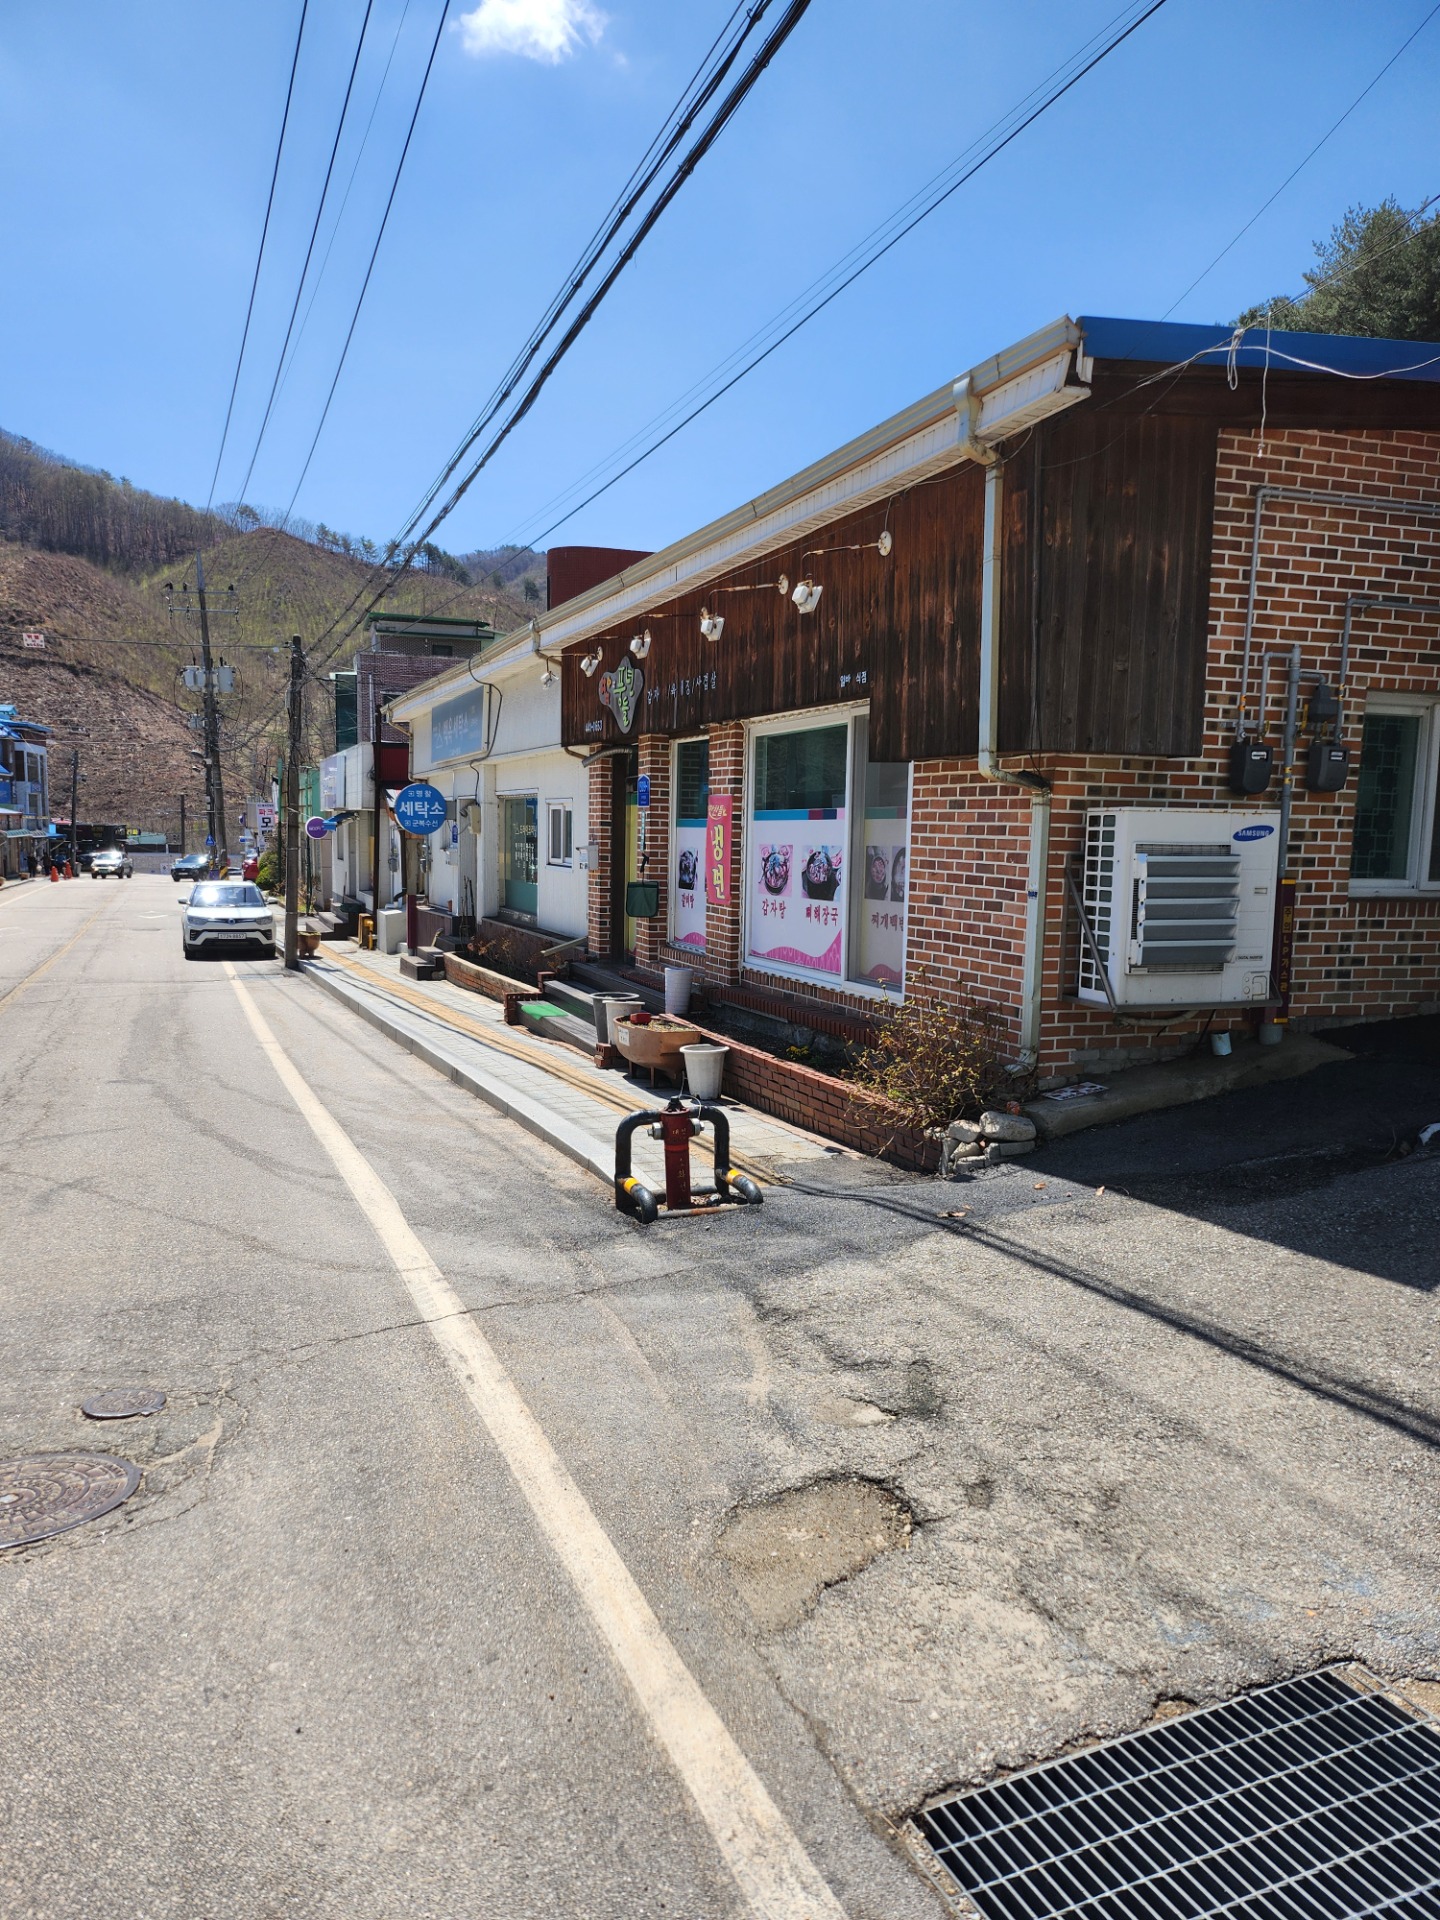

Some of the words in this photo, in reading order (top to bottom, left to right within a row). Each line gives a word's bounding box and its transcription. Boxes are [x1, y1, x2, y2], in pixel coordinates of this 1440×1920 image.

[399, 801, 445, 819] 세탁소
[1237, 829, 1271, 837] SAMSUNG
[710, 824, 726, 900] 냉면
[762, 898, 787, 920] 감자탕
